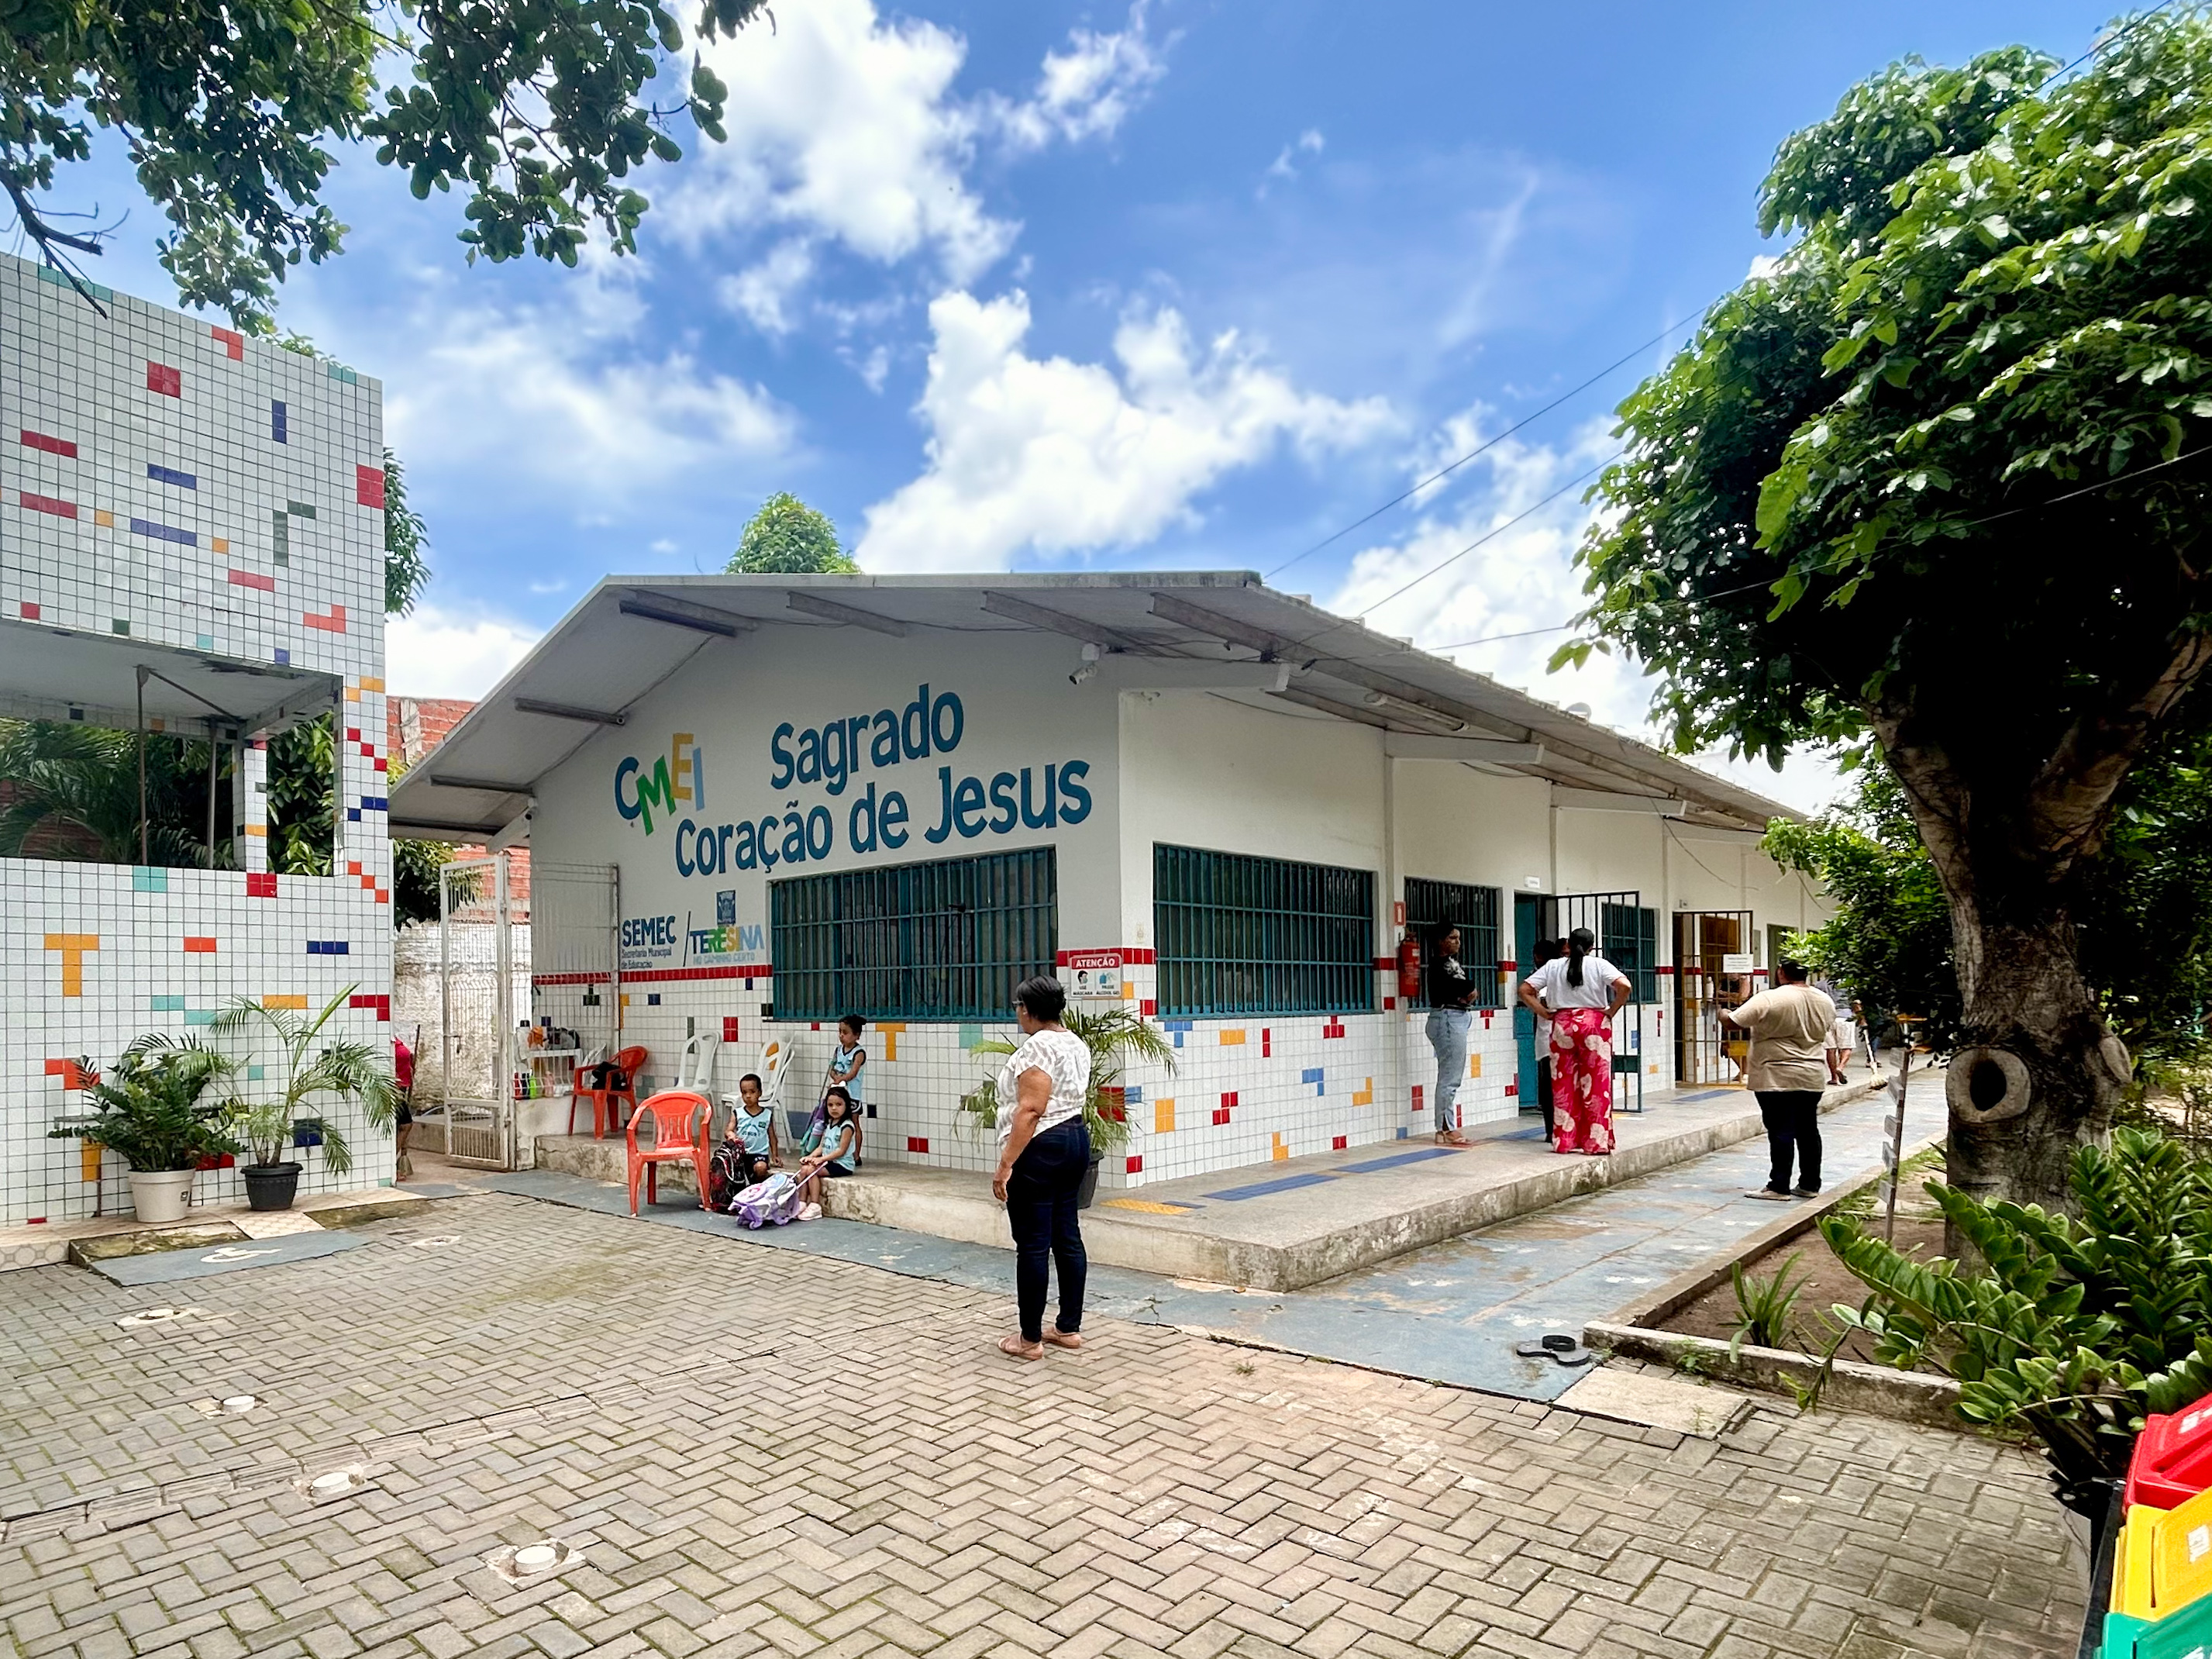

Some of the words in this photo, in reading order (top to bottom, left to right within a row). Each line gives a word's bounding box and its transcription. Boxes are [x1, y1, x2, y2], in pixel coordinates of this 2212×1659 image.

[770, 683, 963, 795] Sagrado
[615, 732, 705, 836] CMEI
[676, 800, 833, 878] Coração
[849, 781, 909, 854] de
[925, 760, 1092, 843] Jesus
[622, 916, 677, 947] SEMEC
[689, 924, 765, 954] TERESINA
[733, 951, 756, 962] CERTO
[1076, 957, 1115, 968] ATENÇÃO
